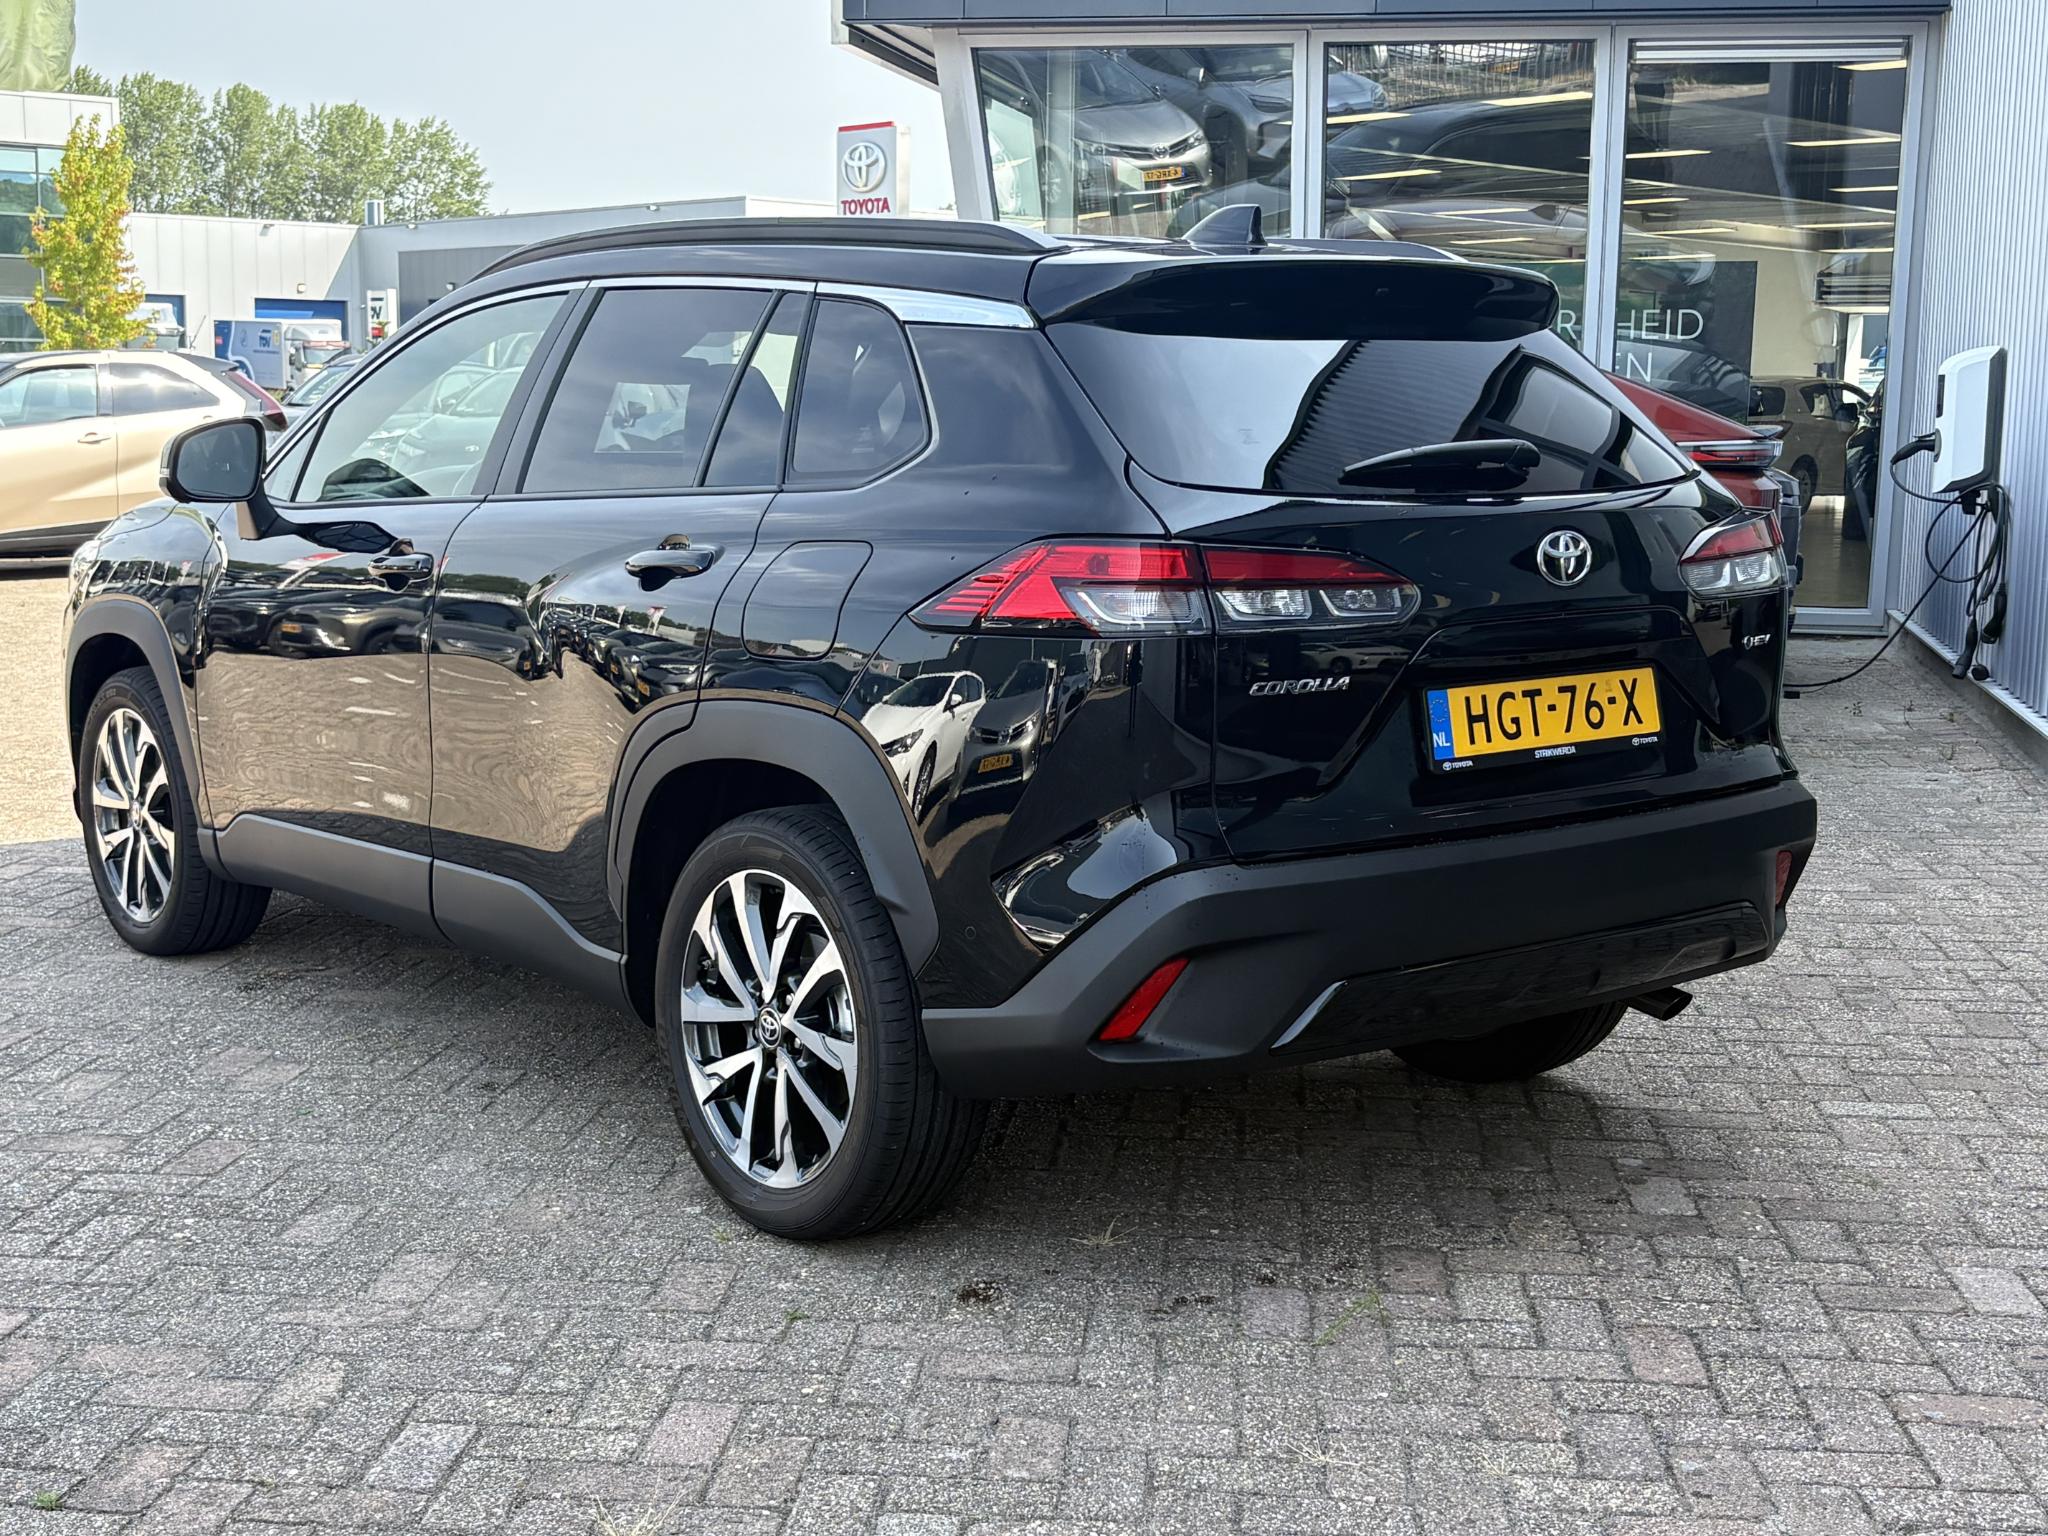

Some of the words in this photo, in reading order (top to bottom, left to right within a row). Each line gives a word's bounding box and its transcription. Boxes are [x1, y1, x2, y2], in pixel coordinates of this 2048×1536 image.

[841, 197, 891, 215] TOYOTA
[1249, 676, 1351, 696] COROLLA
[1464, 677, 1644, 746] HGT-76-X
[1432, 731, 1451, 748] NL
[1452, 760, 1474, 769] TOYOTA
[1534, 745, 1576, 759] STRIKWERDA
[1640, 736, 1659, 745] TOYOTA
